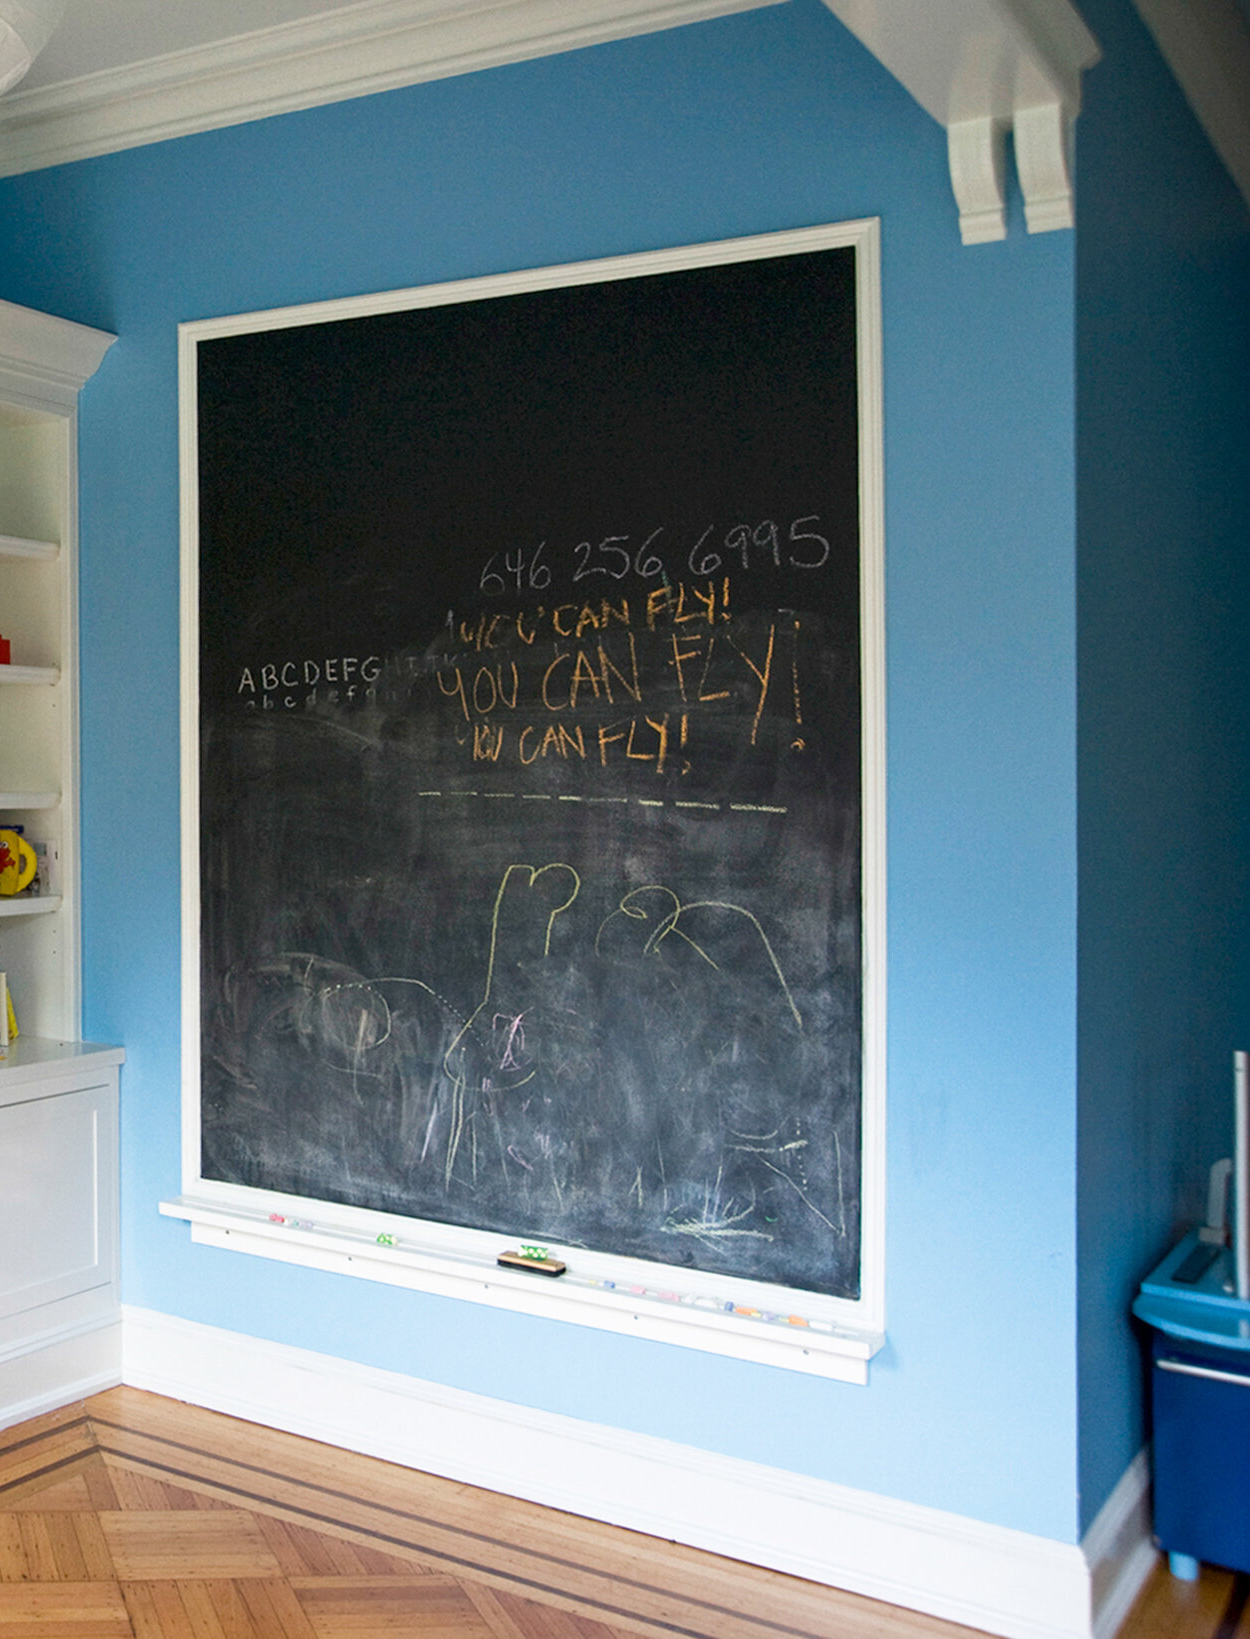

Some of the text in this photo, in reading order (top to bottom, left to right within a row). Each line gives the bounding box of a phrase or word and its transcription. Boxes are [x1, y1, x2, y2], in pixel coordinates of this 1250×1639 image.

[478, 514, 831, 597] 646 256 6995
[553, 599, 632, 638] CAN
[647, 576, 732, 633] FLY!
[437, 620, 807, 751] YOU CAN FLY!
[518, 721, 587, 765] CAN
[598, 712, 693, 776] FLY!
